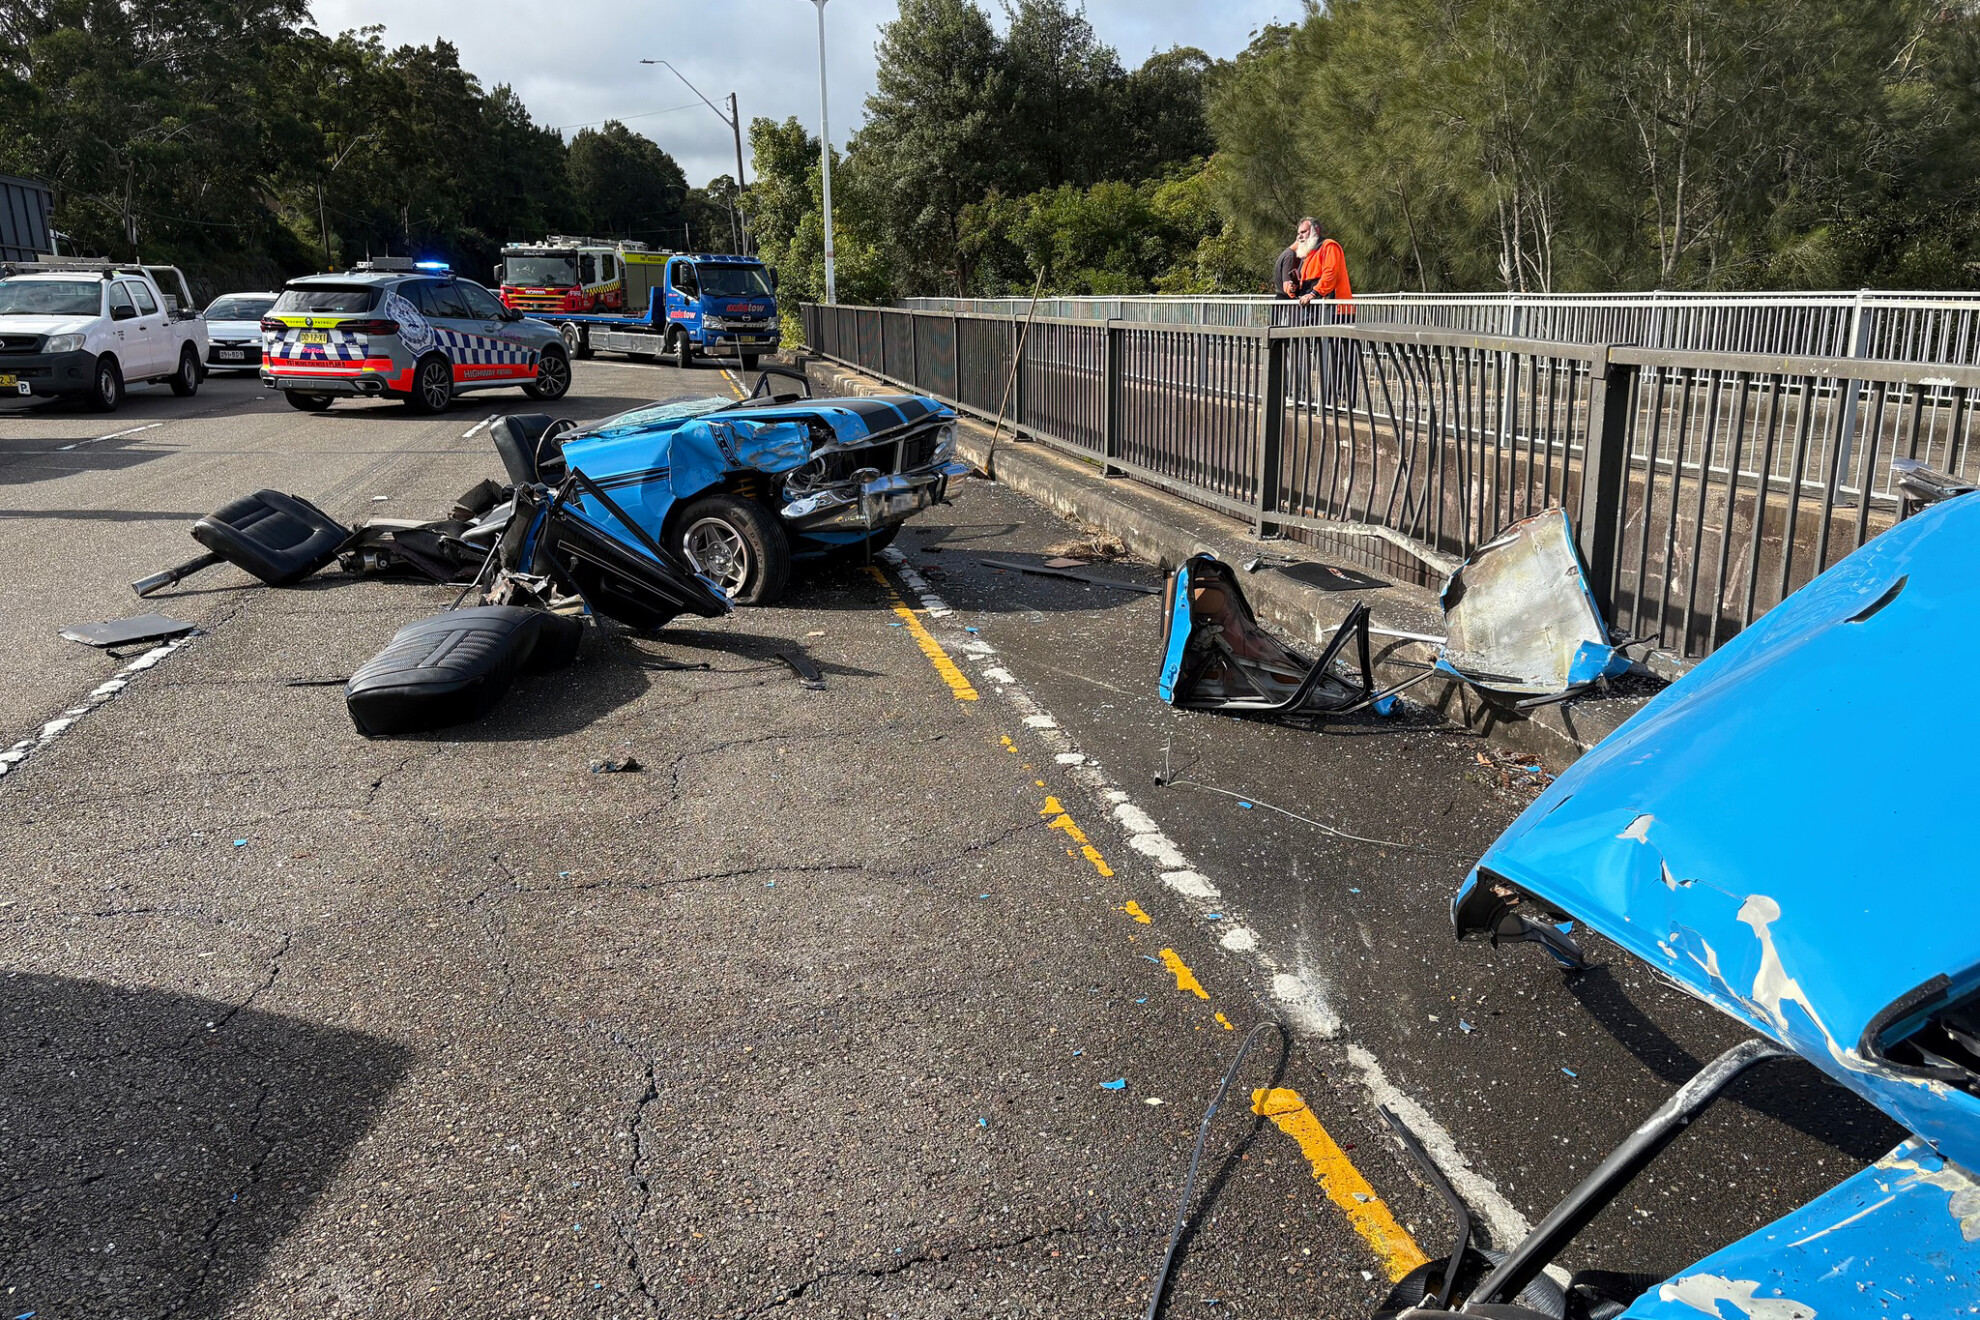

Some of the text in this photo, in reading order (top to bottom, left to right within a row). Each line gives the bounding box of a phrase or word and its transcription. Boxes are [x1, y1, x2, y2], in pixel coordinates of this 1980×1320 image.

[727, 303, 765, 313] autotow
[670, 309, 696, 319] autotow
[464, 369, 495, 379] HIGHWAY
